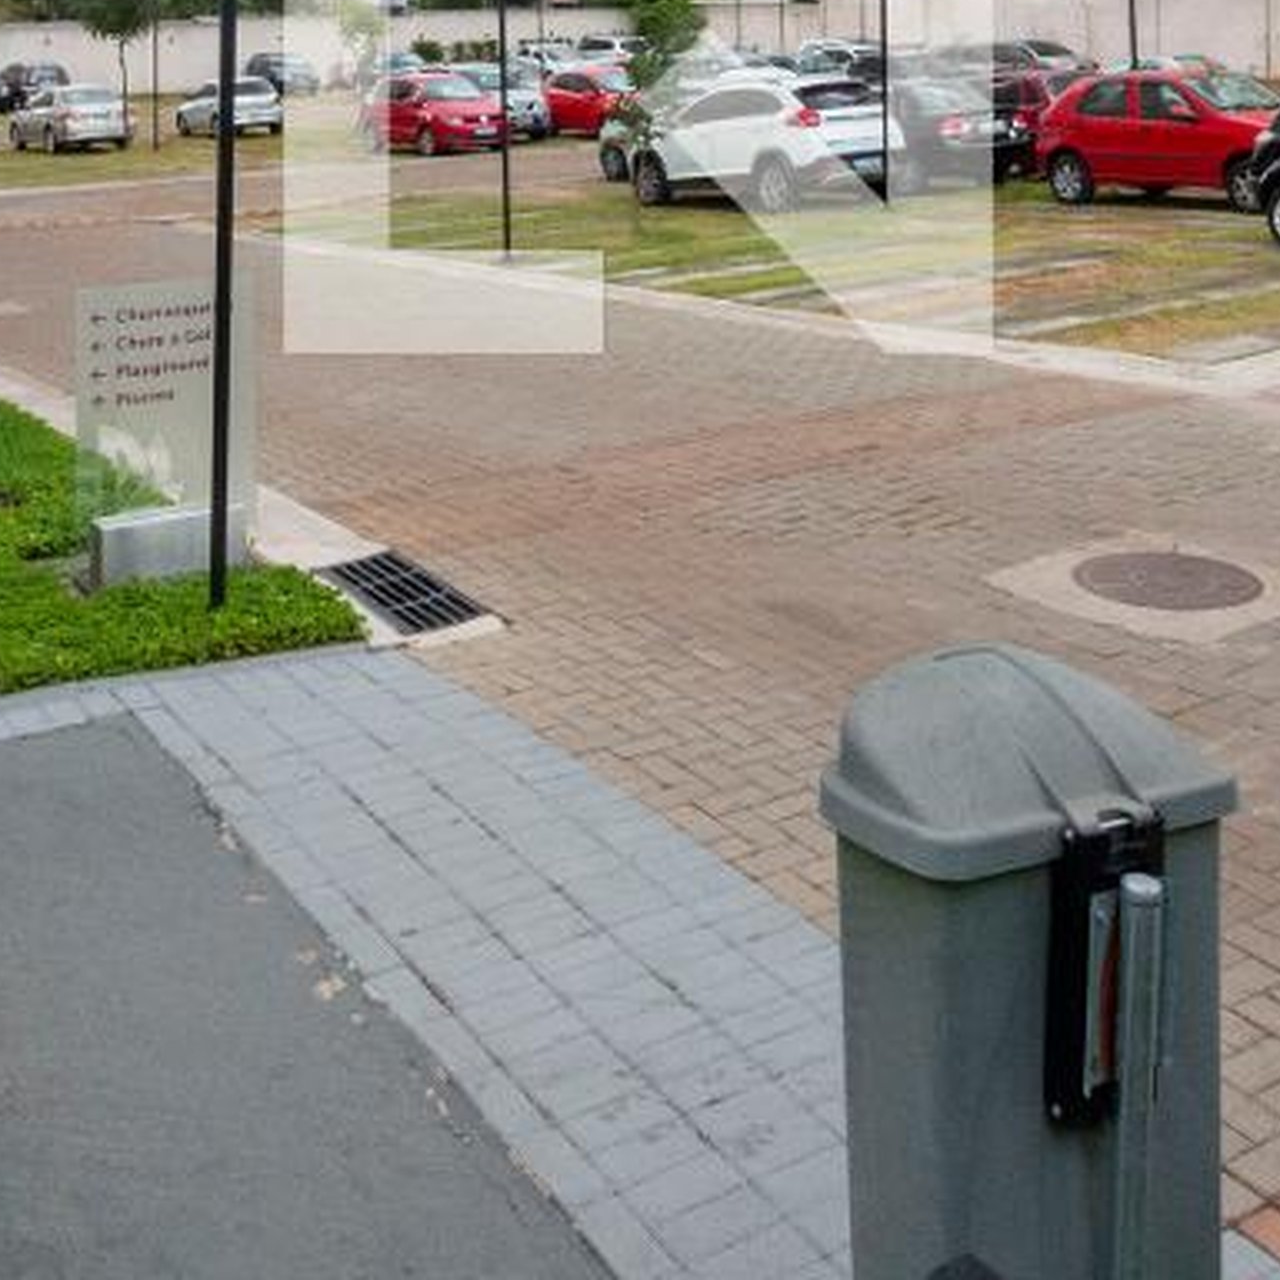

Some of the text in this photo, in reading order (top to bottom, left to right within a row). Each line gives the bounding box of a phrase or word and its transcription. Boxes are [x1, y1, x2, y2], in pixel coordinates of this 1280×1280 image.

[116, 301, 211, 323] Churrasquei
[116, 357, 210, 380] Playground
[116, 388, 175, 407] Piscina
